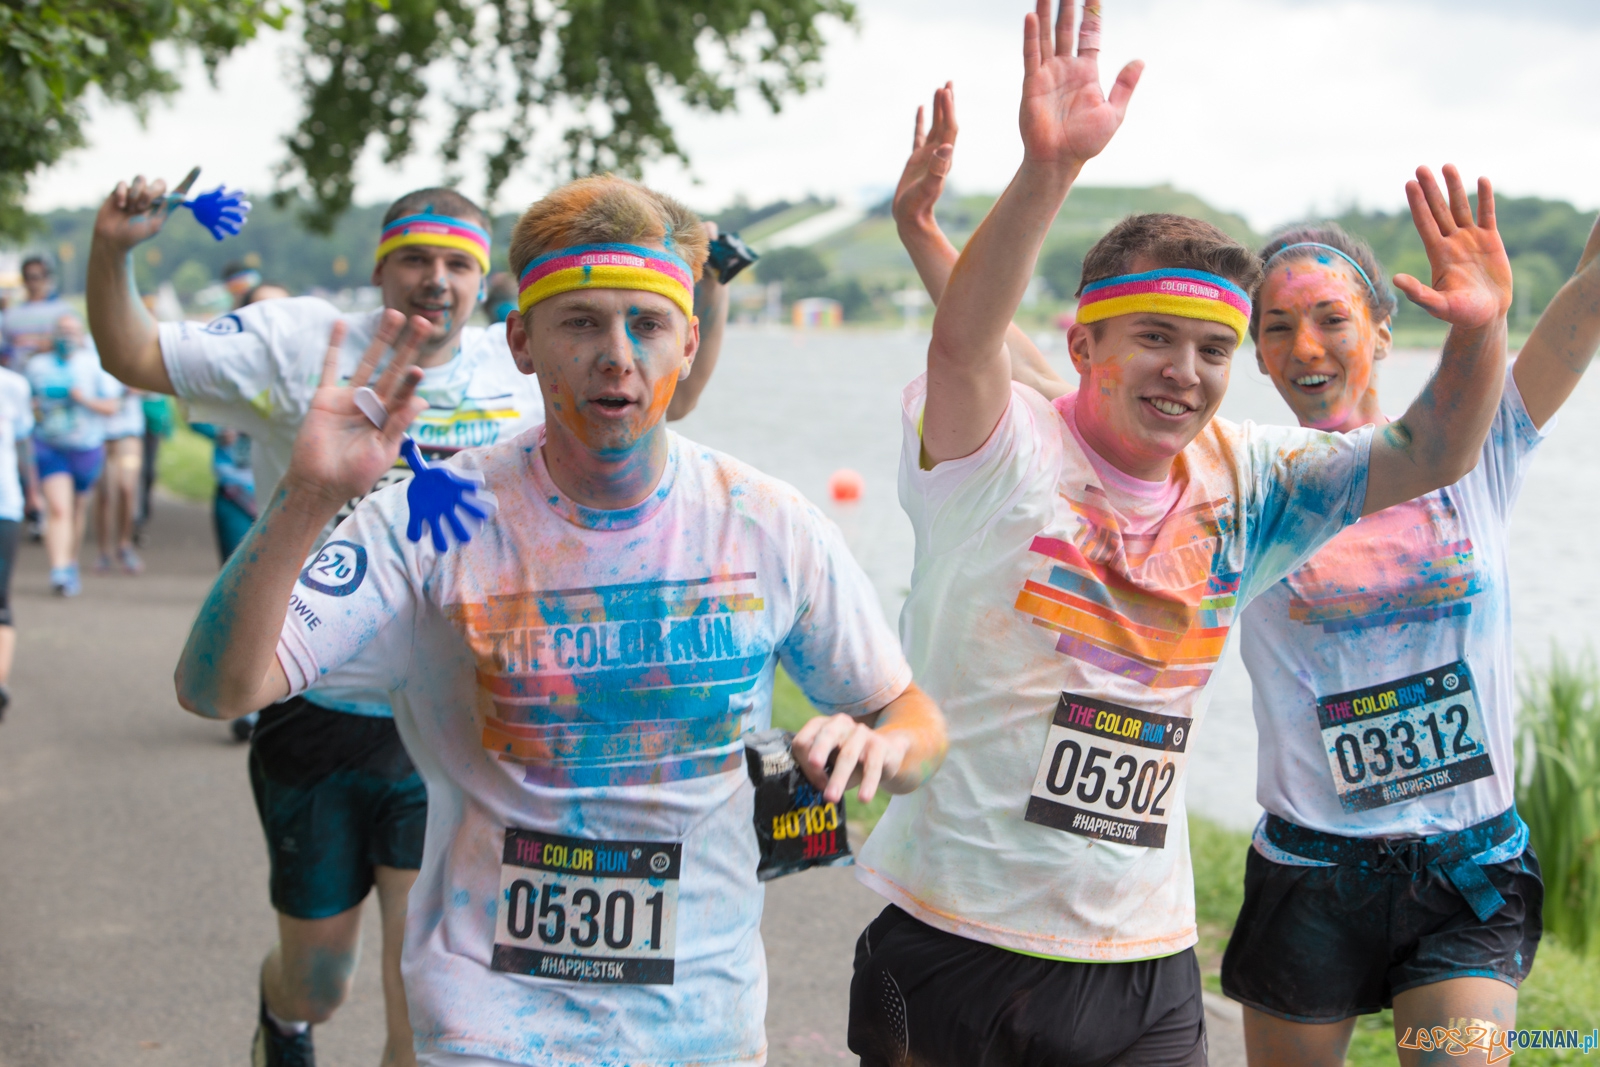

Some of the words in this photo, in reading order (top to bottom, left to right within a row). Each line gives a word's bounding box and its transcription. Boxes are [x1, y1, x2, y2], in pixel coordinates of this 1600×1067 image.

[581, 254, 609, 265] COLOR
[611, 254, 645, 267] RUNNER
[1161, 280, 1187, 293] COLOR
[1188, 283, 1219, 299] RUNNER
[288, 594, 322, 632] OWIE
[488, 629, 548, 673] THE
[553, 620, 665, 669] COLOR
[1067, 703, 1097, 728] THE
[1094, 711, 1142, 739] COLOR
[1325, 701, 1354, 722] THE
[1353, 690, 1399, 716] COLOR
[1335, 704, 1477, 785] 03312
[1046, 739, 1176, 817] 05302
[1382, 769, 1453, 801] #HAPPIEST5K
[772, 802, 839, 841] COLOR
[1072, 813, 1140, 840] #HAPPIEST5K
[515, 837, 542, 864] THE
[542, 843, 594, 872] COLOR
[802, 831, 838, 860] THE
[506, 878, 665, 951] 05301
[540, 955, 625, 980] #HAPPIEST5K
